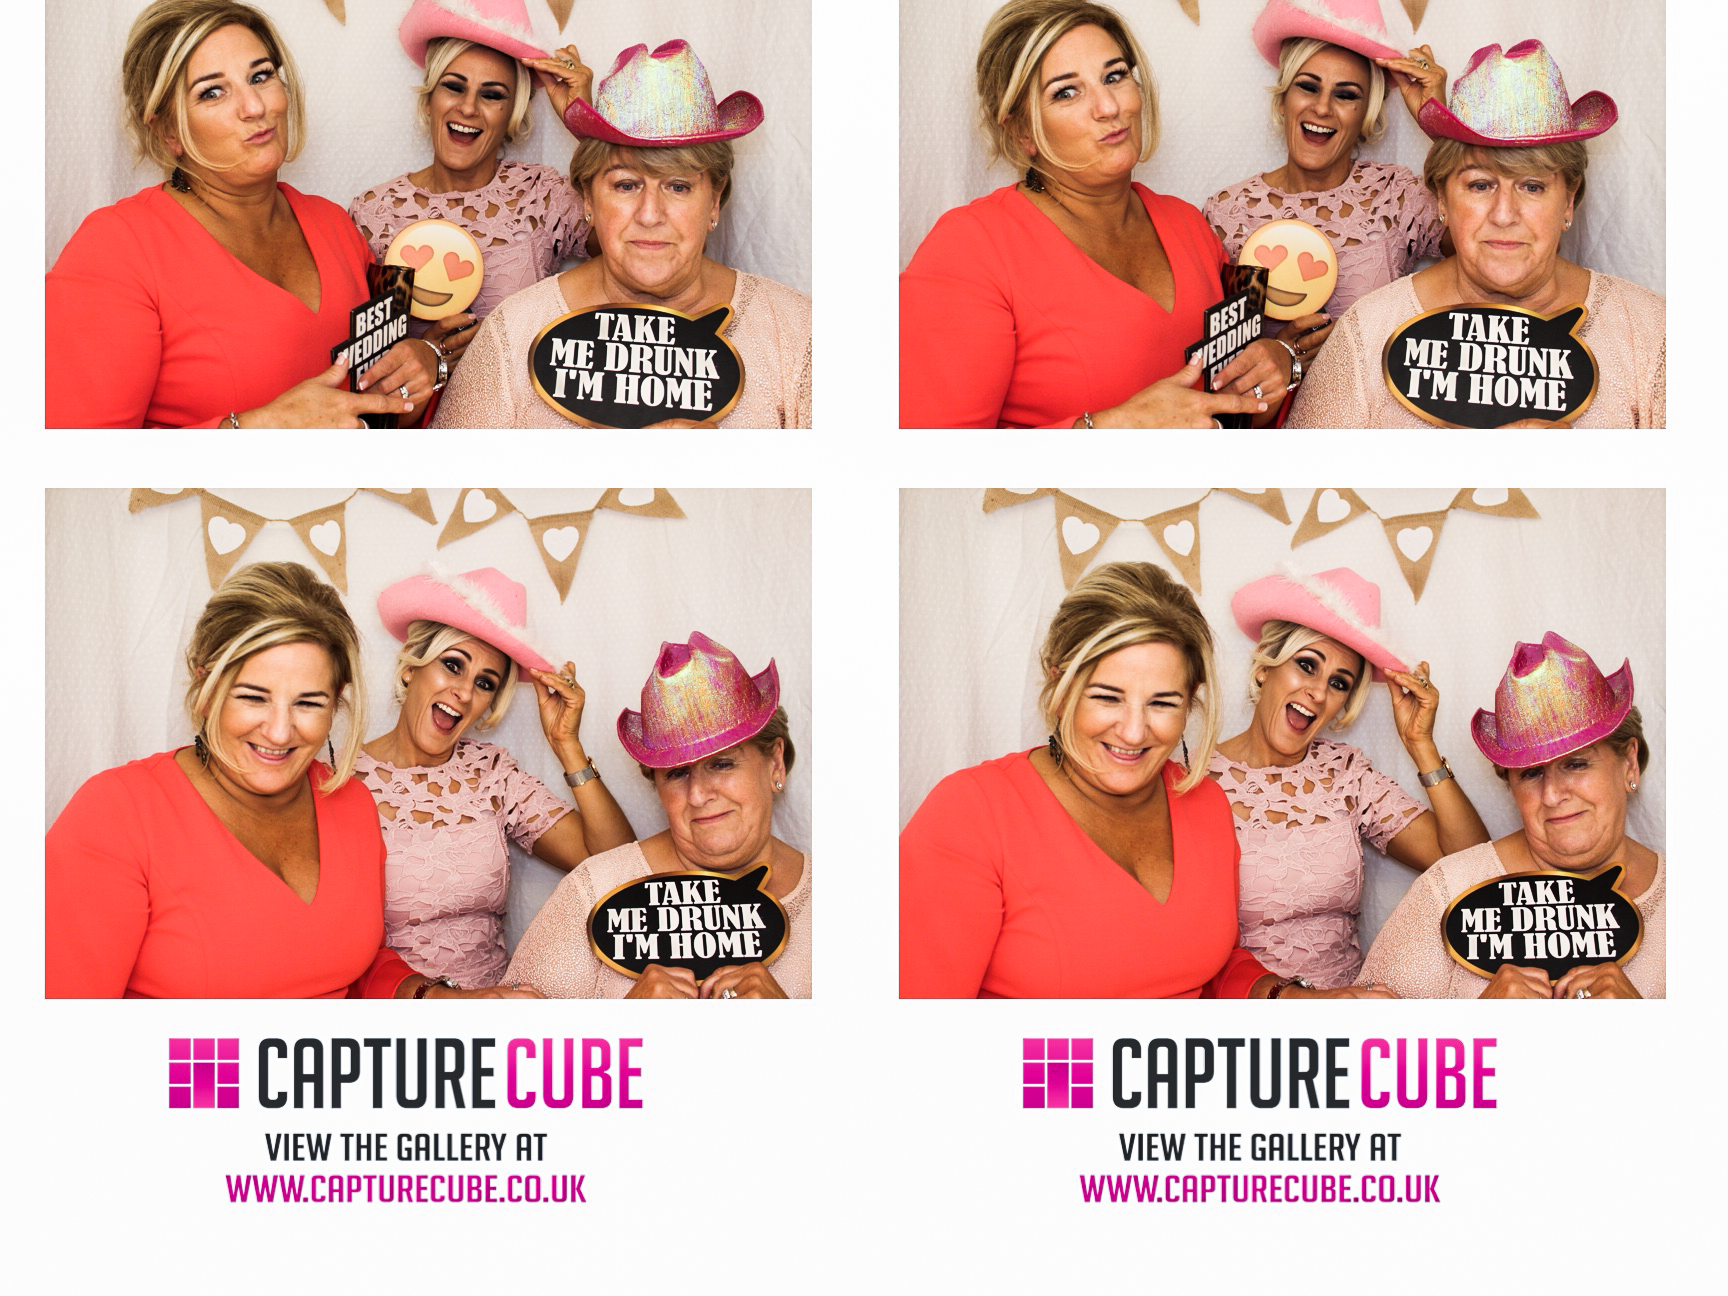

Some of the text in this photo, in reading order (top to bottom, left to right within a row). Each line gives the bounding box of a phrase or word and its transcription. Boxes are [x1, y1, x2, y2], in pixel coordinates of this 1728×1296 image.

[355, 295, 394, 339] BEST
[594, 312, 676, 345] TAKE
[1209, 295, 1248, 339] BEST
[1448, 312, 1530, 345] TAKE
[549, 337, 720, 380] ME DRUNK
[1403, 337, 1574, 380] ME DRUNK
[552, 367, 713, 412] I'M HOME
[1406, 367, 1567, 412] I'M HOME
[644, 879, 722, 906] TAKE
[1498, 879, 1576, 906] TAKE
[606, 903, 767, 933] ME DRUNK
[1460, 903, 1621, 933] ME DRUNK
[612, 930, 763, 960] I'M HOME
[1466, 930, 1617, 960] I'M HOME
